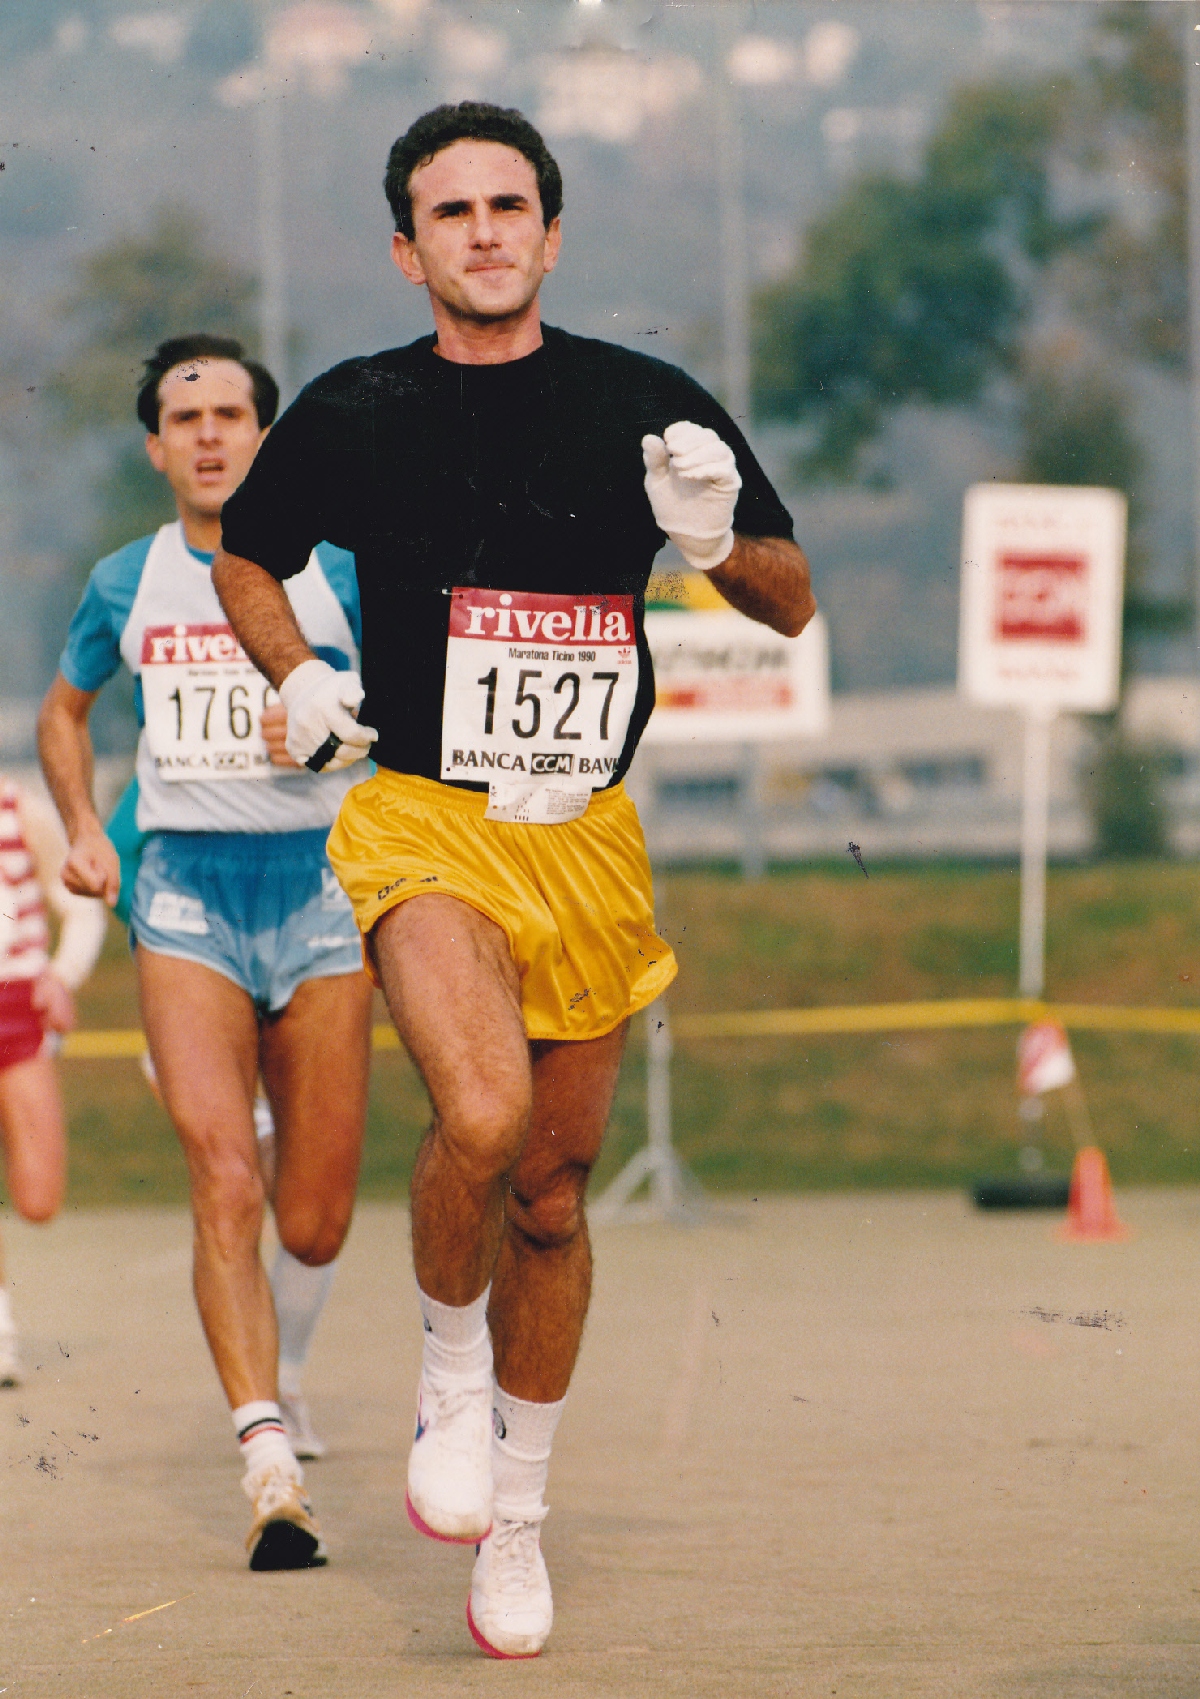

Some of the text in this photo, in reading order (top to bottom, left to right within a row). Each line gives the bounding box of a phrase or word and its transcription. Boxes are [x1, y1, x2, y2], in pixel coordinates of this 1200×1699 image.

[464, 593, 631, 642] rivella
[508, 647, 597, 662] Maratona Ticino 1990
[477, 667, 619, 741] 1527
[452, 748, 527, 772] BANCA
[531, 754, 573, 774] CCM
